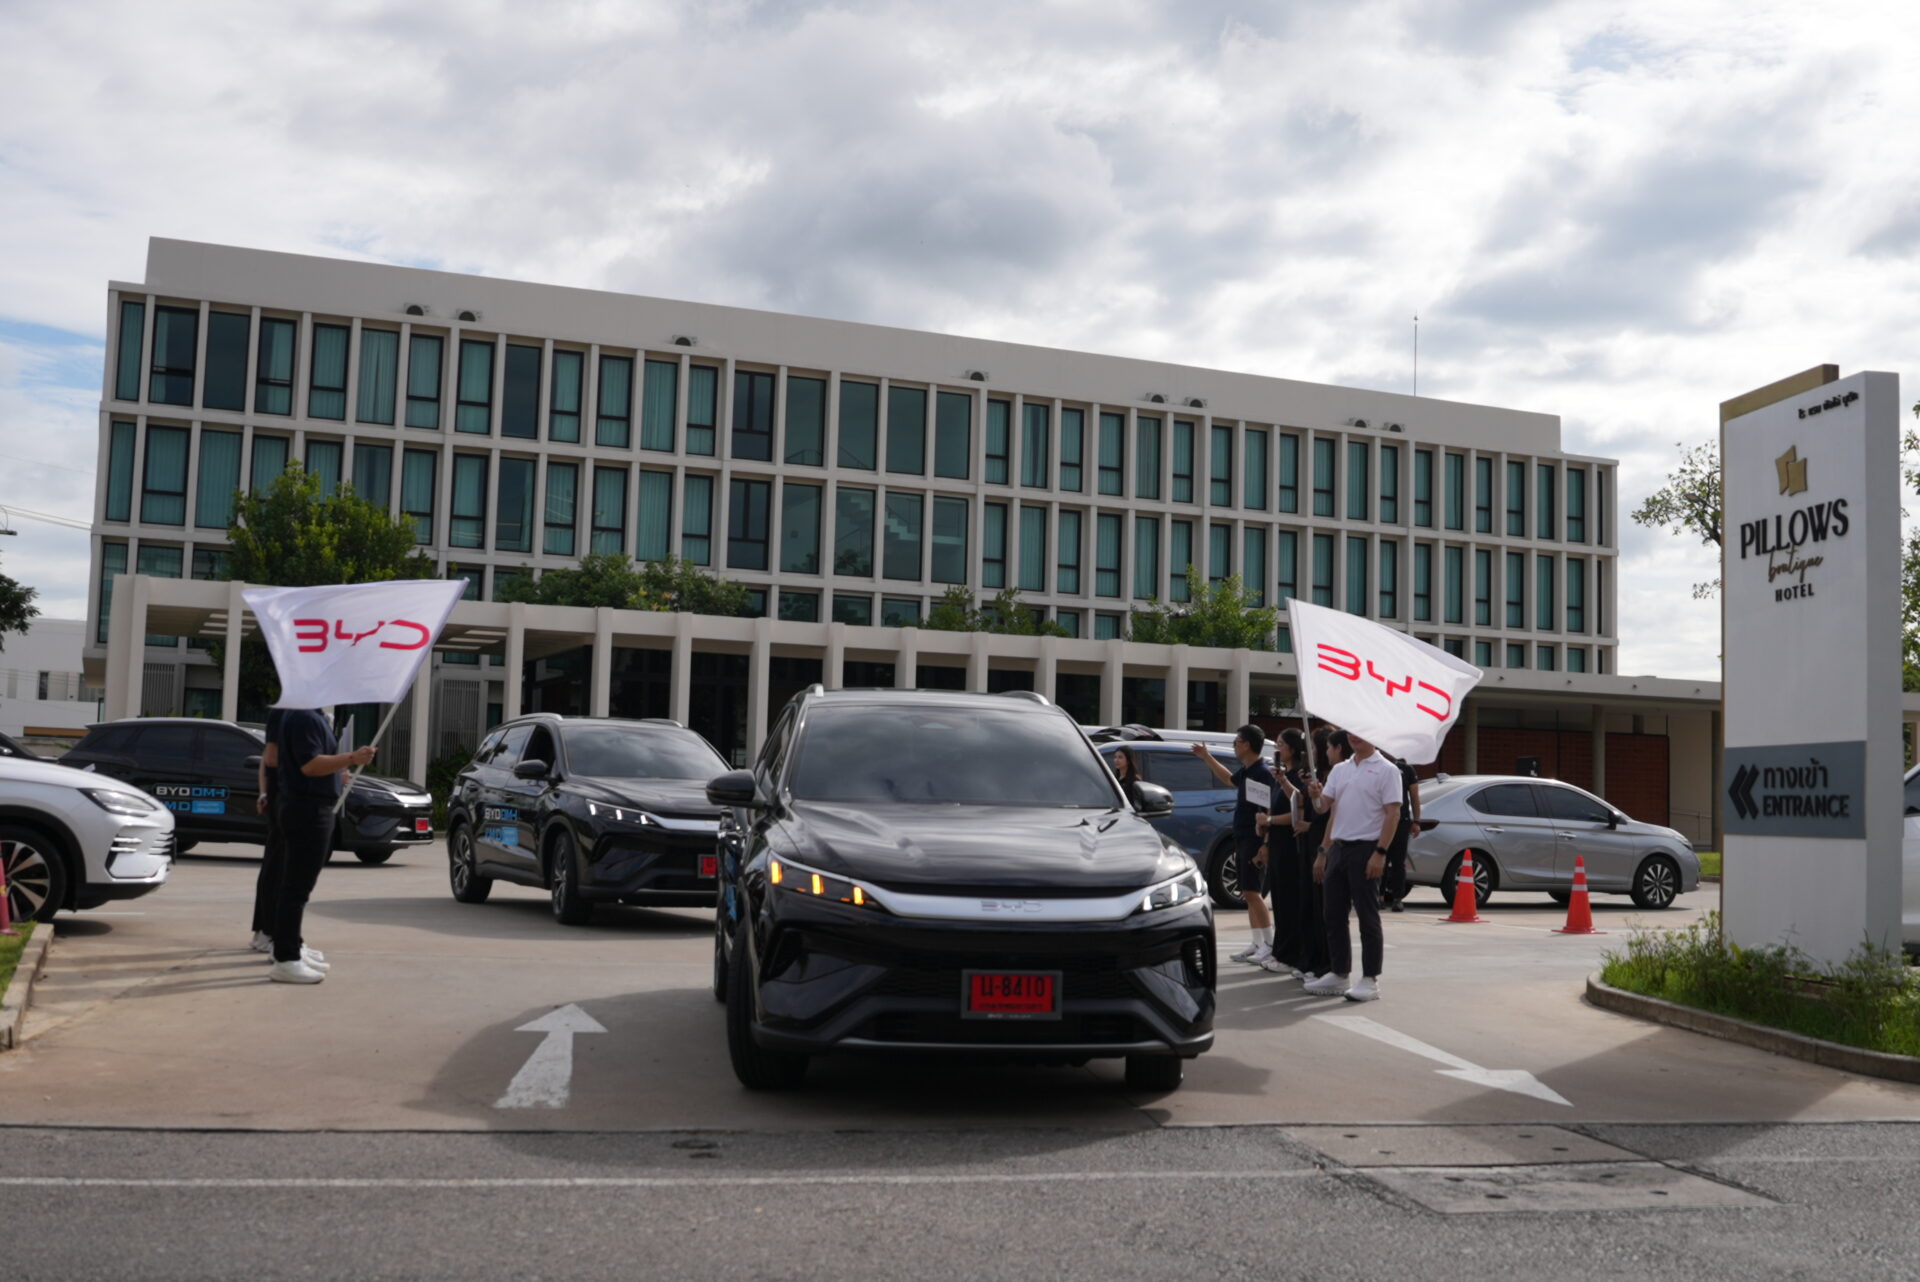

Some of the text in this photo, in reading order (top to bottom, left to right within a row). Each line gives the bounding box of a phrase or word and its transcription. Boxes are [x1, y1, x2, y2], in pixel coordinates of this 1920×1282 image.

[1740, 498, 1849, 559] PILLOWS
[1768, 547, 1824, 583] boutique
[1775, 583, 1815, 602] HOTEL
[293, 619, 430, 653] BYD
[1317, 643, 1452, 722] BYD
[1763, 757, 1829, 789] ทางเข้า
[156, 786, 190, 796] BYD
[1763, 795, 1850, 819] ENTRANCE
[980, 900, 1043, 913] BYD
